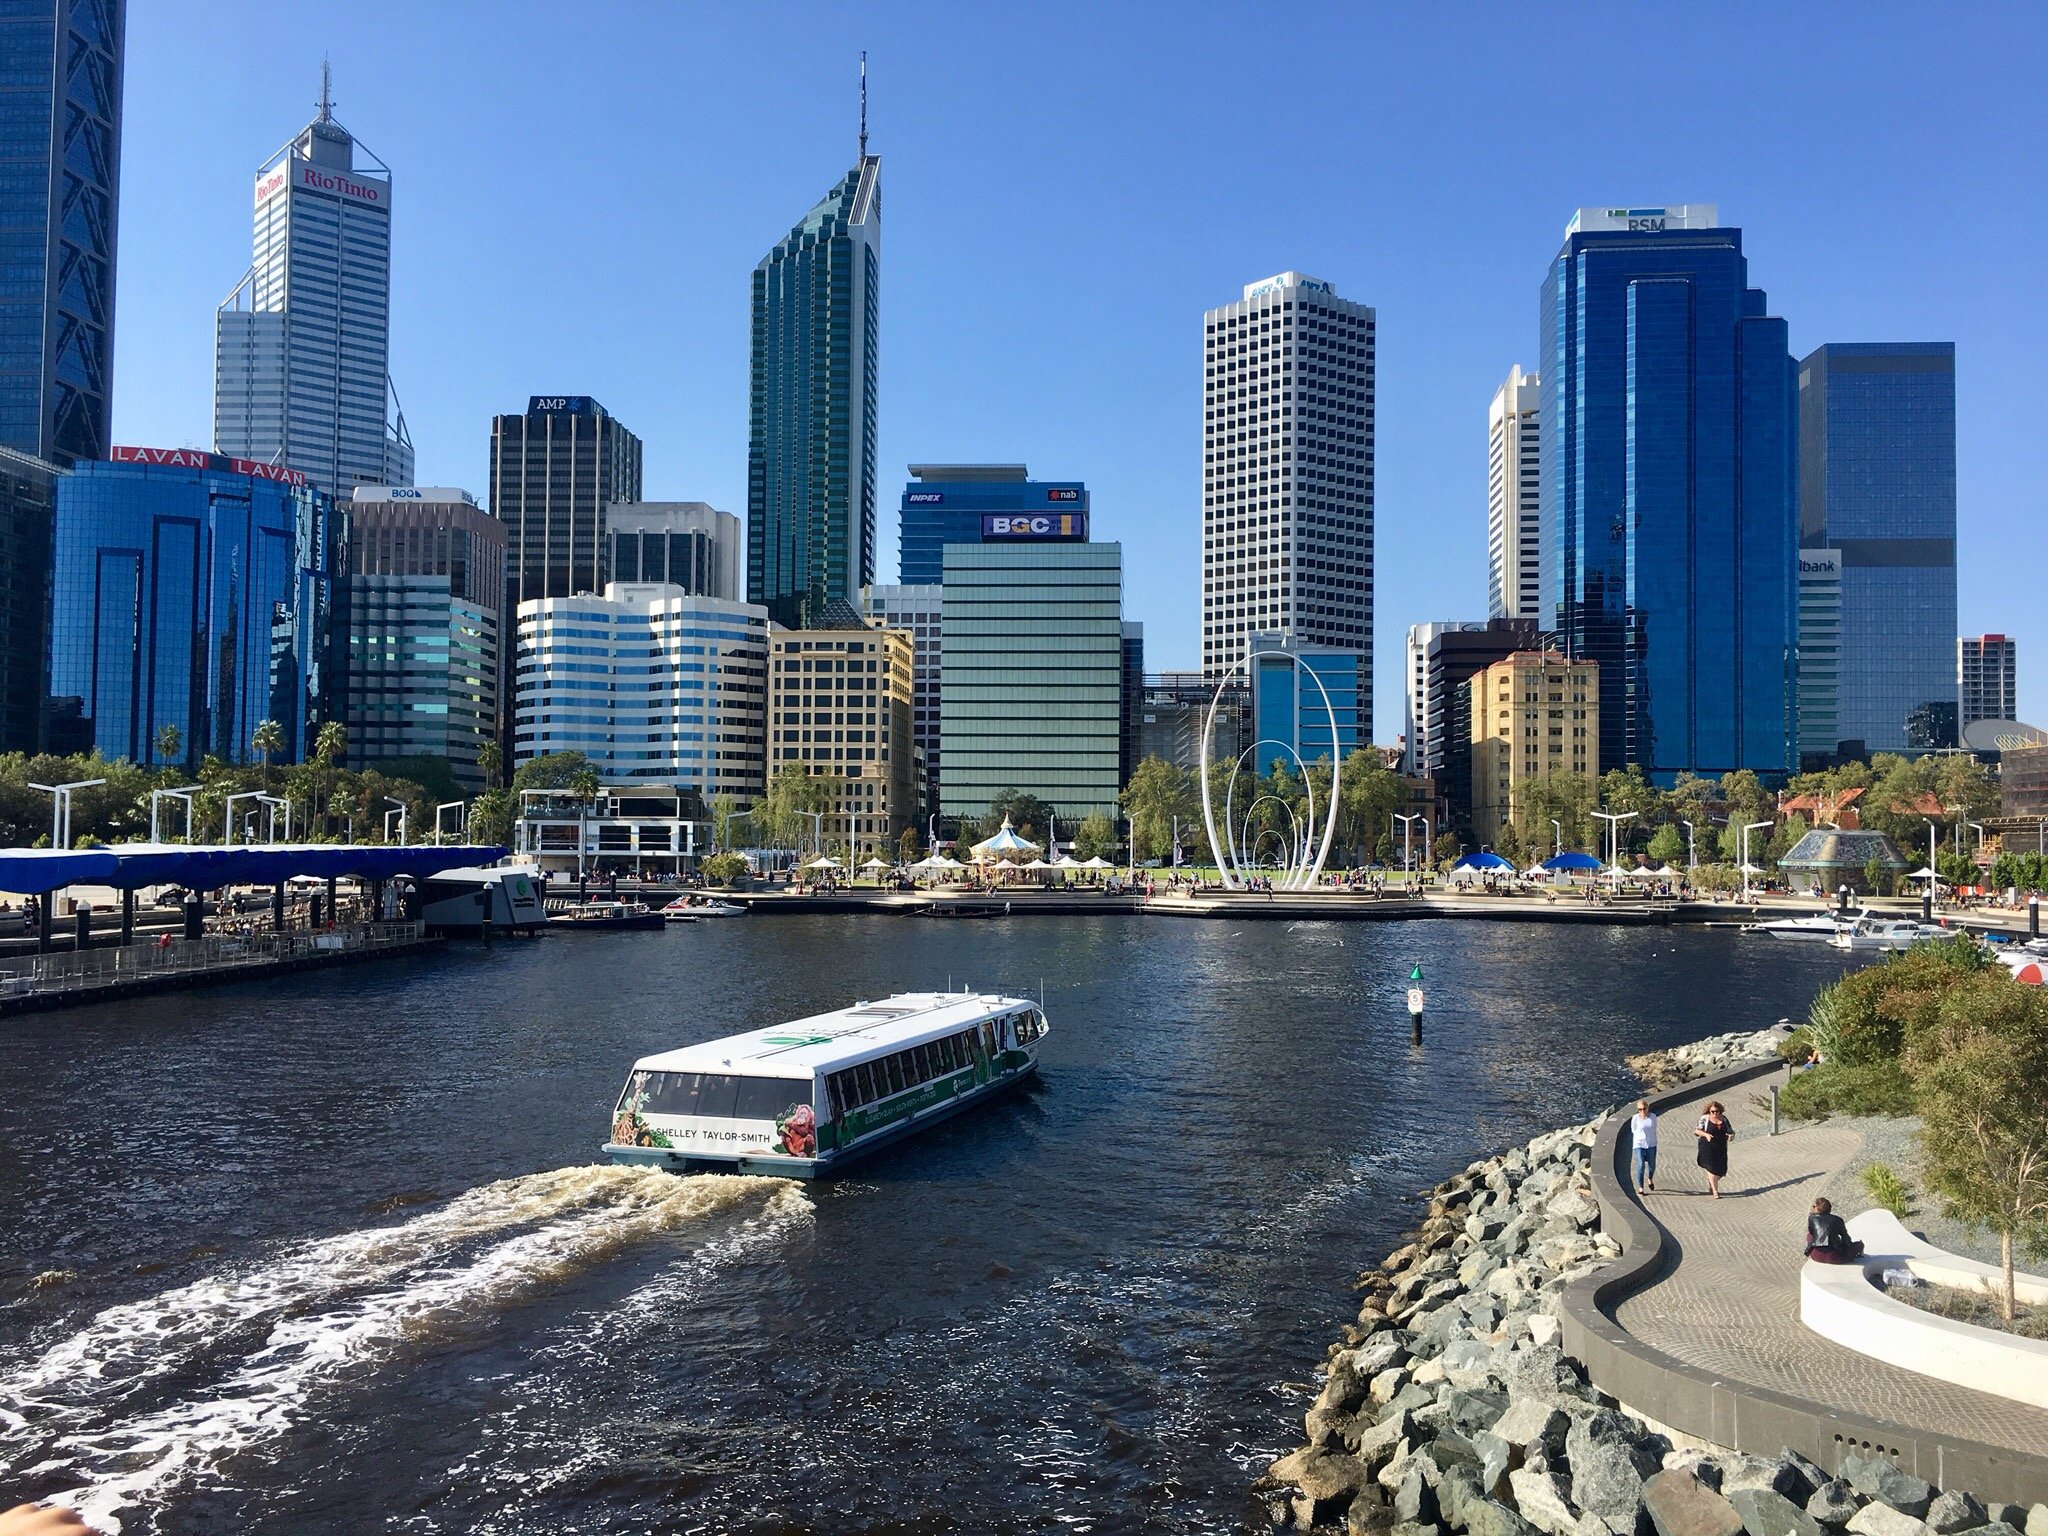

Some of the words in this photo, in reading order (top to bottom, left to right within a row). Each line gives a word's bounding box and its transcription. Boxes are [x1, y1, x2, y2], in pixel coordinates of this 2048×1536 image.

[1629, 218, 1666, 231] RSM
[536, 398, 566, 410] AMP
[116, 447, 205, 468] LAVAN
[236, 459, 303, 487] LAVAN
[391, 489, 415, 498] BOQ
[909, 494, 941, 502] INPEX
[1060, 490, 1077, 499] nab
[993, 517, 1050, 533] BGC
[1412, 994, 1419, 1003] 5
[656, 1127, 698, 1138] SHELLEY
[702, 1131, 771, 1143] TAYLOR-SMITH
